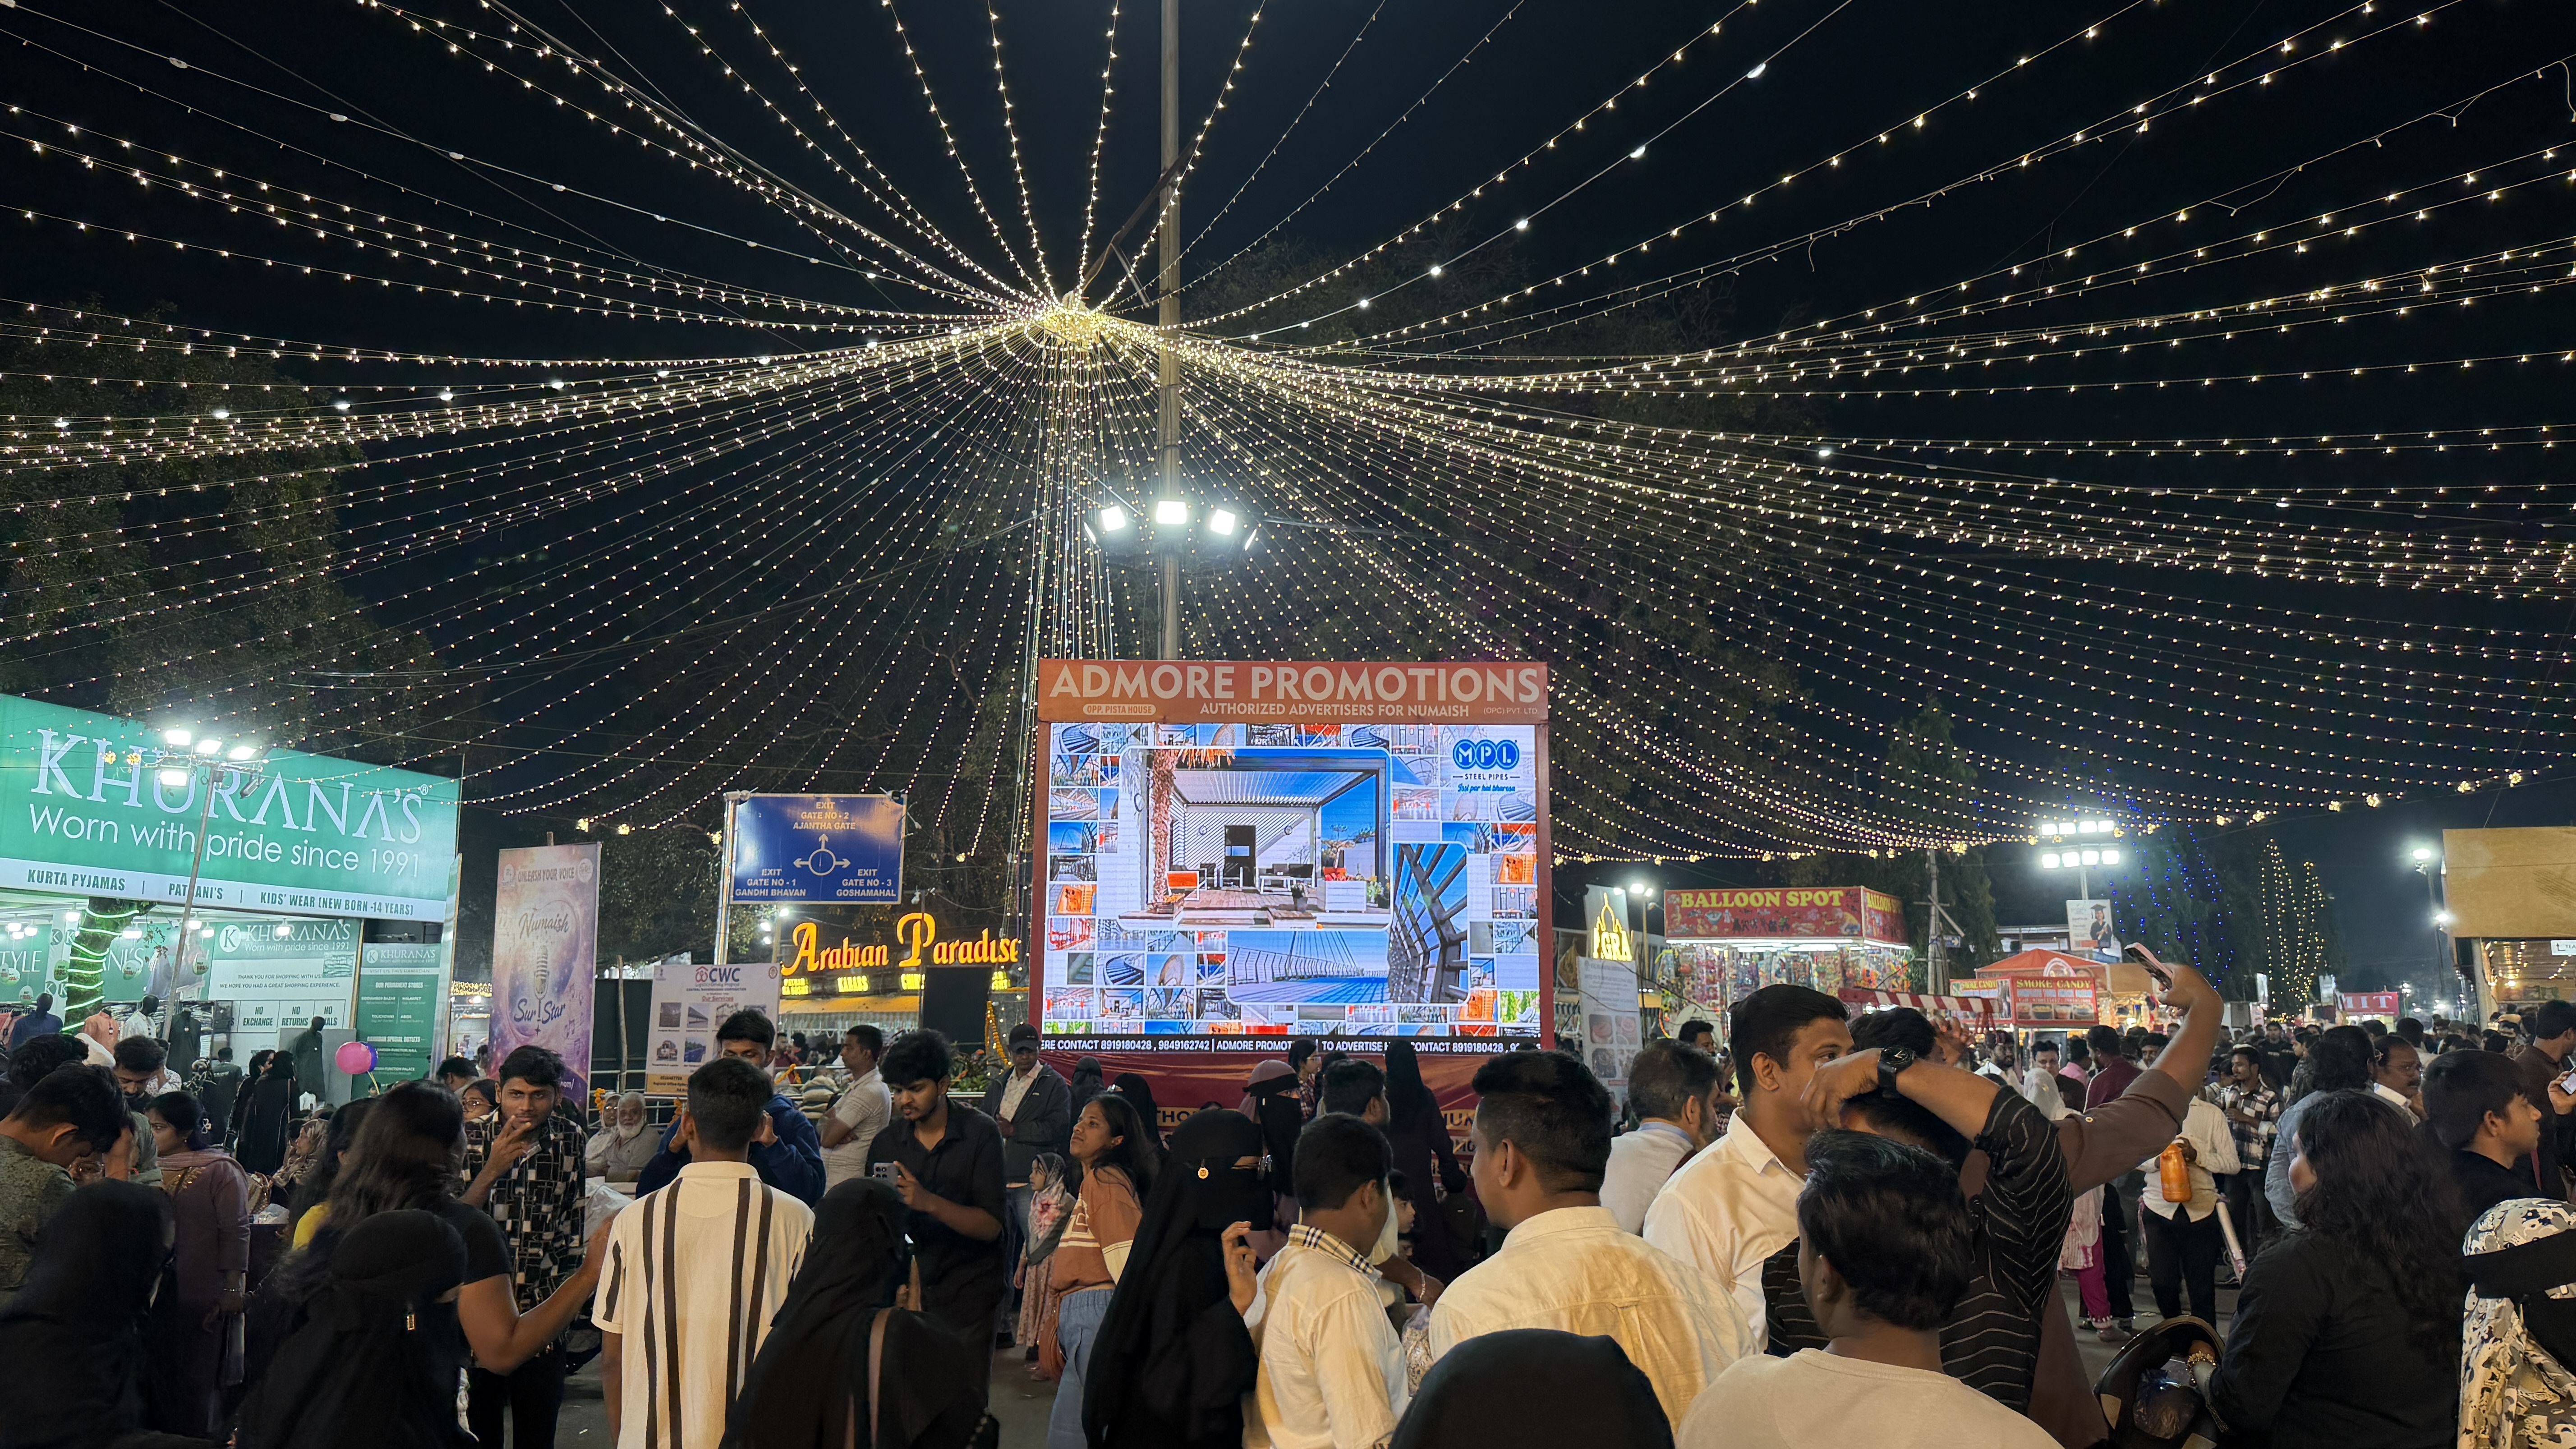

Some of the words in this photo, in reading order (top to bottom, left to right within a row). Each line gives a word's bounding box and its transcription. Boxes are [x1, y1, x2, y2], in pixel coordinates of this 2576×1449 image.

[1049, 664, 1234, 699] ADMORE
[1251, 666, 1540, 703] PROMOTIONS
[1087, 705, 1103, 714] OPP.
[1105, 705, 1126, 714] PISTA
[1128, 706, 1152, 714] HOUSE
[1200, 703, 1286, 715] AUTHORIZED
[1288, 703, 1374, 716] ADVERTISERS
[1378, 704, 1404, 716] FOR
[1408, 705, 1469, 717] NUMAISH
[29, 803, 119, 844] Worn
[130, 820, 195, 853] with
[206, 830, 282, 863] pride
[290, 839, 359, 871] since
[371, 848, 419, 878] 1991
[518, 869, 541, 883] UNLEASH
[543, 868, 557, 882] YOUR
[559, 866, 575, 879] VOICE
[28, 869, 67, 886] KURTA
[71, 872, 126, 892] PYJAMAS
[169, 883, 223, 900] PATANI'S
[836, 889, 897, 897] GOSHAMAHAL
[260, 892, 286, 905] KIDS'
[289, 894, 316, 908] WEAR
[318, 896, 341, 910] (NEW
[344, 897, 368, 912] BORN
[370, 901, 382, 913] -14
[384, 902, 414, 915] YEARS)
[1680, 891, 1780, 908] BALLOON
[1786, 890, 1843, 907] SPOT
[1866, 892, 1892, 912] BALLOON
[519, 912, 570, 939] Numaish
[224, 929, 238, 948] K
[781, 922, 889, 976] Arabian
[896, 912, 1019, 968] Paradise
[245, 943, 265, 952] Worn
[267, 943, 283, 952] with
[285, 942, 306, 952] pride
[308, 942, 329, 951] since
[332, 942, 349, 951] 1991
[369, 952, 375, 961] K
[381, 949, 436, 959] KHURANA'S
[709, 967, 741, 982] CWC
[1962, 981, 1978, 989] SMOKE
[1978, 980, 1996, 989] CANDY
[2016, 980, 2052, 988] SMOKE
[2056, 980, 2091, 989] CANDY
[255, 1006, 263, 1015] NO
[292, 1006, 300, 1015] NO
[324, 1006, 332, 1015] NO
[513, 998, 536, 1023] Sur
[542, 1000, 566, 1025] Star
[243, 1017, 273, 1026] EXCHANGE
[281, 1017, 308, 1026] RETURNS
[1058, 1040, 1099, 1050] CONTACT
[1101, 1040, 1152, 1050] 8919180428
[1158, 1040, 1210, 1050] 9849162742
[1216, 1040, 1253, 1050] ADMORE
[1322, 1041, 1334, 1051] TO
[1335, 1041, 1383, 1051] ADVERTISE
[1452, 1042, 1504, 1053] 8919180428
